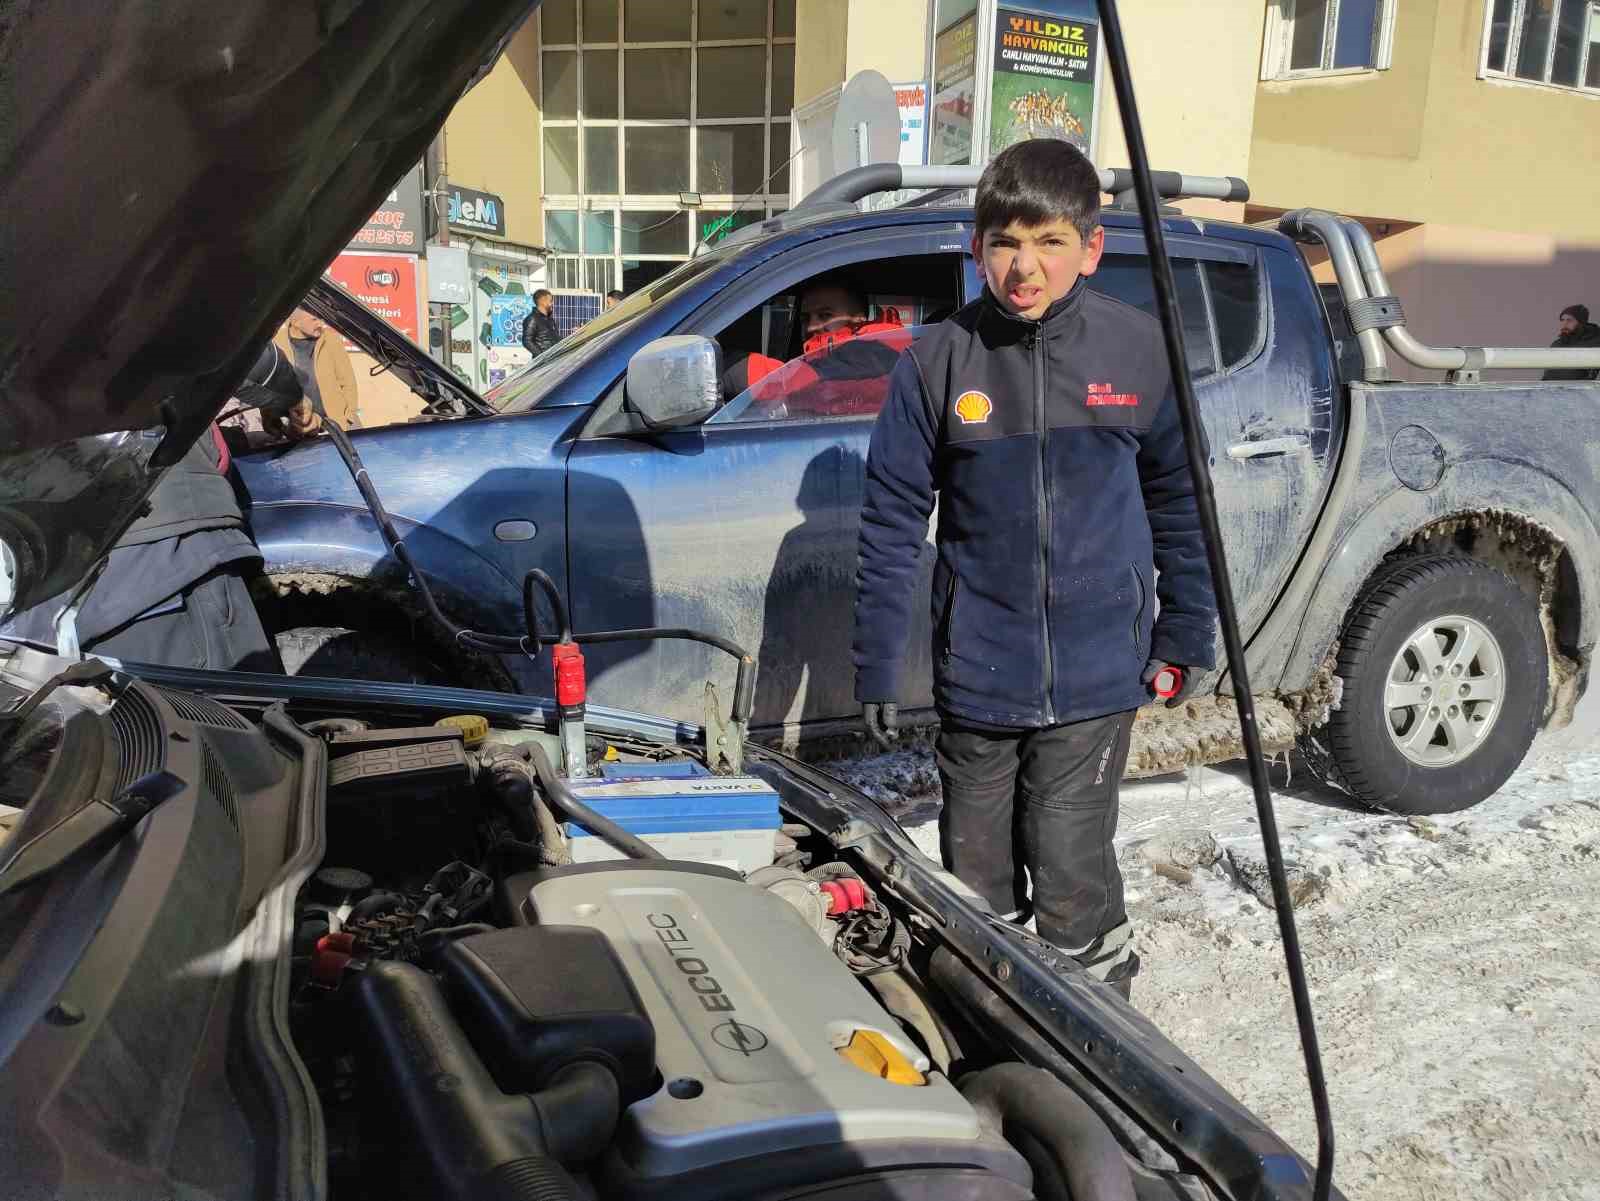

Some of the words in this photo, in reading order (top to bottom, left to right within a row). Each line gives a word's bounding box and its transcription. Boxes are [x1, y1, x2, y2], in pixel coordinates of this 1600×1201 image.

[1008, 16, 1084, 40] YILDIZ
[1002, 33, 1088, 57] HAYVANCILIK
[1002, 49, 1022, 60] CANLI
[1022, 52, 1049, 63] HAYVAN
[1049, 56, 1064, 66] ALIM
[1019, 63, 1074, 78] KOMİSYONCULUK
[448, 191, 498, 225] gleM
[376, 229, 395, 244] 25
[395, 231, 416, 245] 75
[646, 913, 736, 1011] ECOTEC
